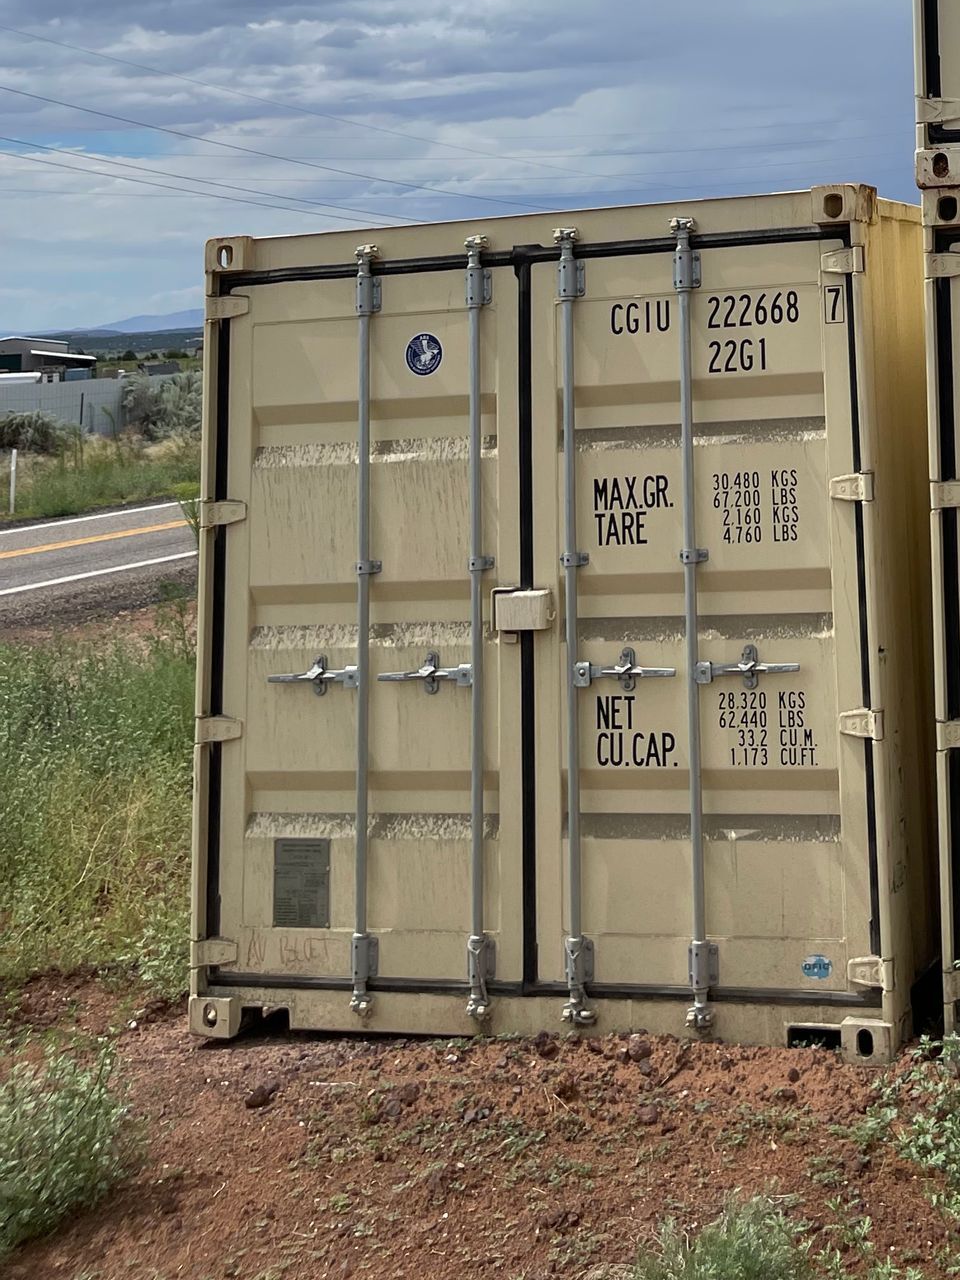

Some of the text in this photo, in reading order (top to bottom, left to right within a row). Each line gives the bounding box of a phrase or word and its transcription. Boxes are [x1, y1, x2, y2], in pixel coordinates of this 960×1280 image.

[610, 287, 841, 335] CGIU 222668 7
[708, 337, 766, 374] 22G1
[712, 469, 798, 491] 30,480 KGS
[593, 474, 674, 513] MAX.GR.
[713, 487, 797, 510] 67,200 LBS
[594, 509, 648, 547] TARE
[722, 505, 799, 528] 2,160 KGS
[723, 523, 798, 544] 4,760 LBS
[718, 691, 806, 710] 28,320 KGS
[596, 695, 636, 730] NET
[719, 709, 804, 729] 62,440 LBS
[738, 728, 818, 747] 33.2 CU.M.
[596, 732, 678, 767] CU.CAP.
[730, 747, 819, 766] 1,173 CU.FT.
